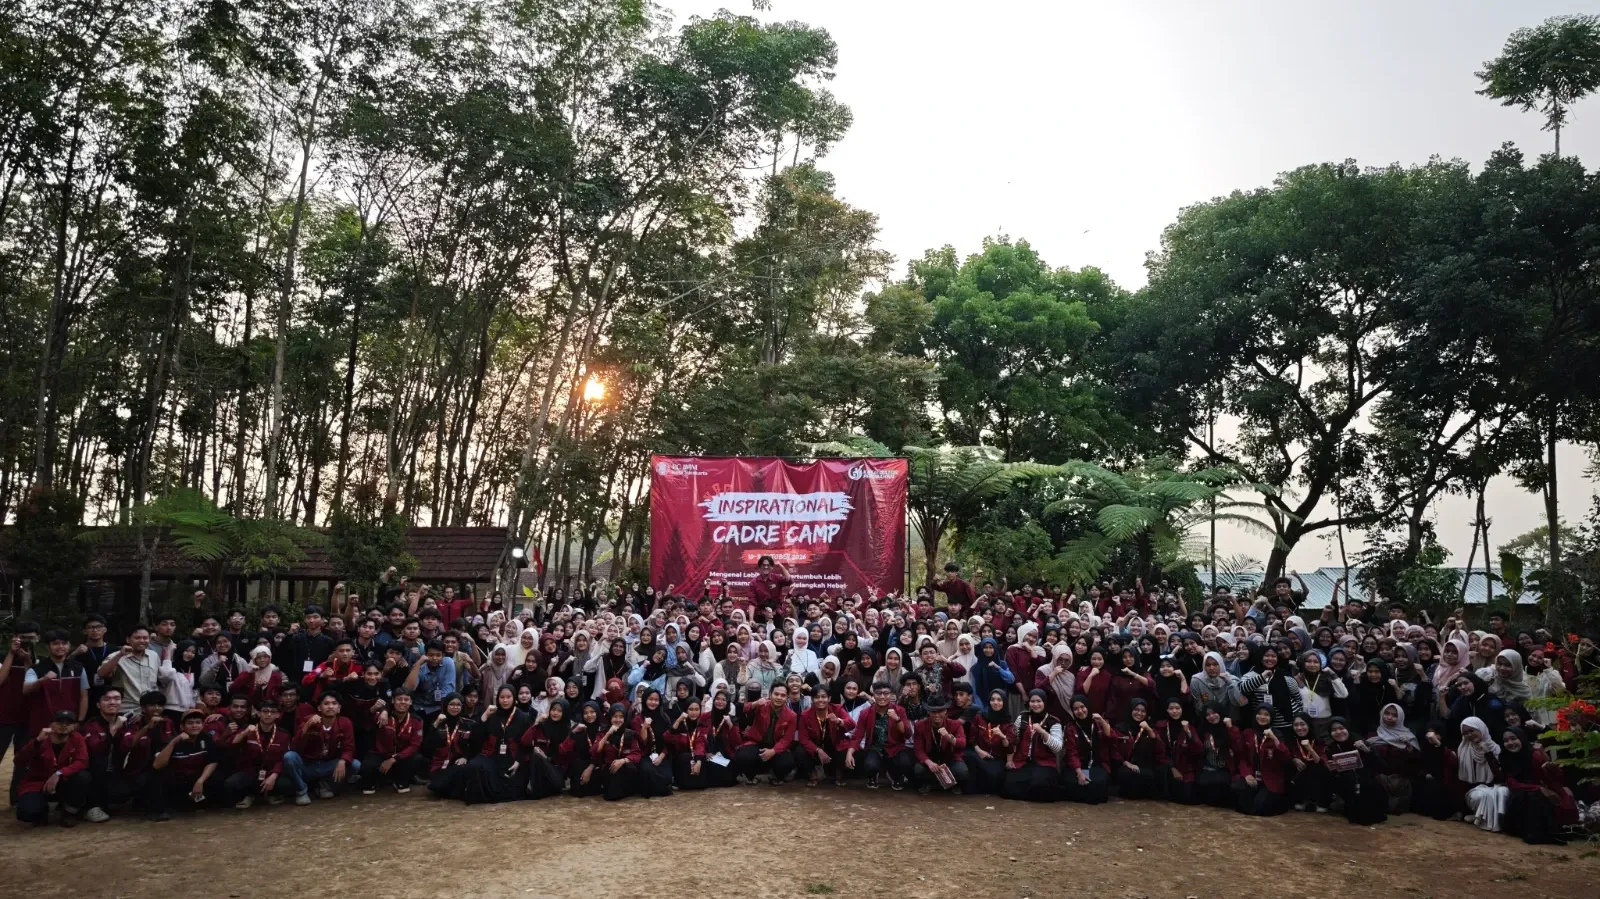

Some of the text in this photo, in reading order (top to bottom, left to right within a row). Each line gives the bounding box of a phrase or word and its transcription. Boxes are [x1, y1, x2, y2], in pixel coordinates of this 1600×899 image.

[719, 499, 840, 515] INSPIRATIONAL
[713, 524, 840, 546] CADRE CAMP
